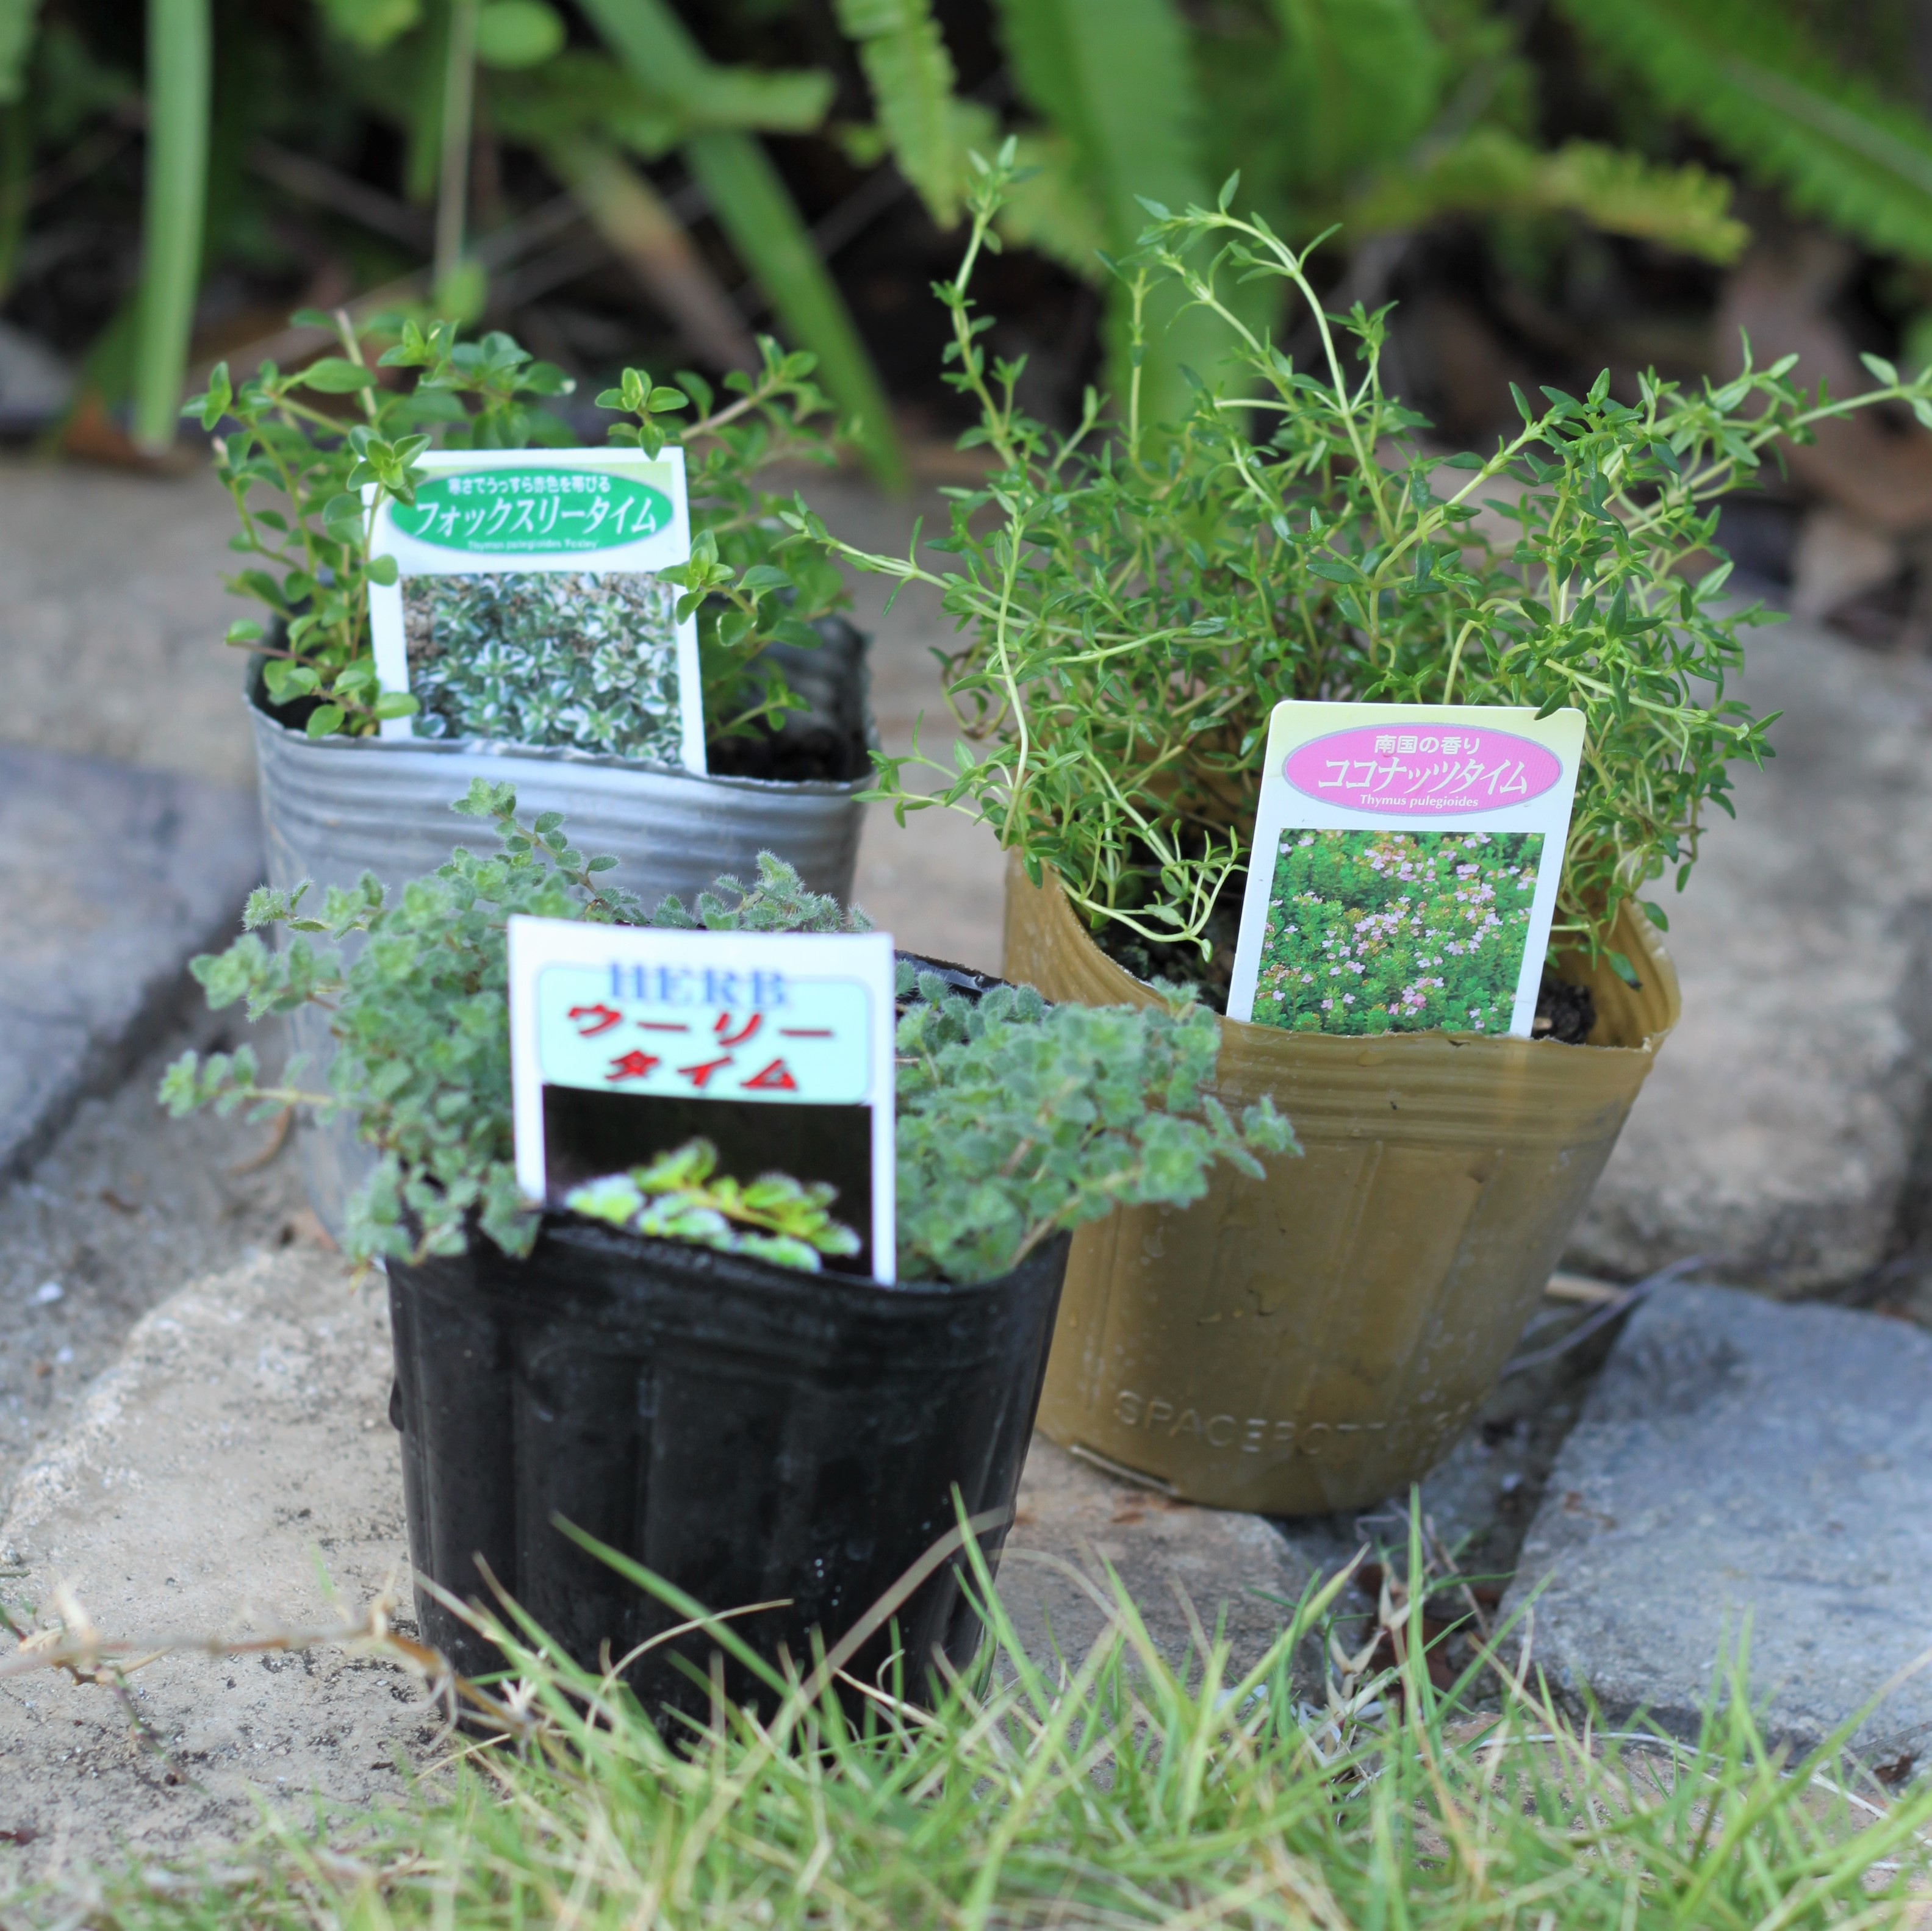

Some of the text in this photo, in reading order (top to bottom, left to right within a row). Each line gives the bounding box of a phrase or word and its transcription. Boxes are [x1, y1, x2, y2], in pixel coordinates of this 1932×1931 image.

[414, 496, 656, 537] フォックスリータイム
[1374, 734, 1481, 755] 南国の香り
[1318, 756, 1528, 795] ココナッツタイム
[1360, 794, 1479, 809] Thymus pulegioides
[610, 962, 788, 1007] HERB
[567, 1003, 835, 1047] ウーリー
[605, 1050, 797, 1089] タイム
